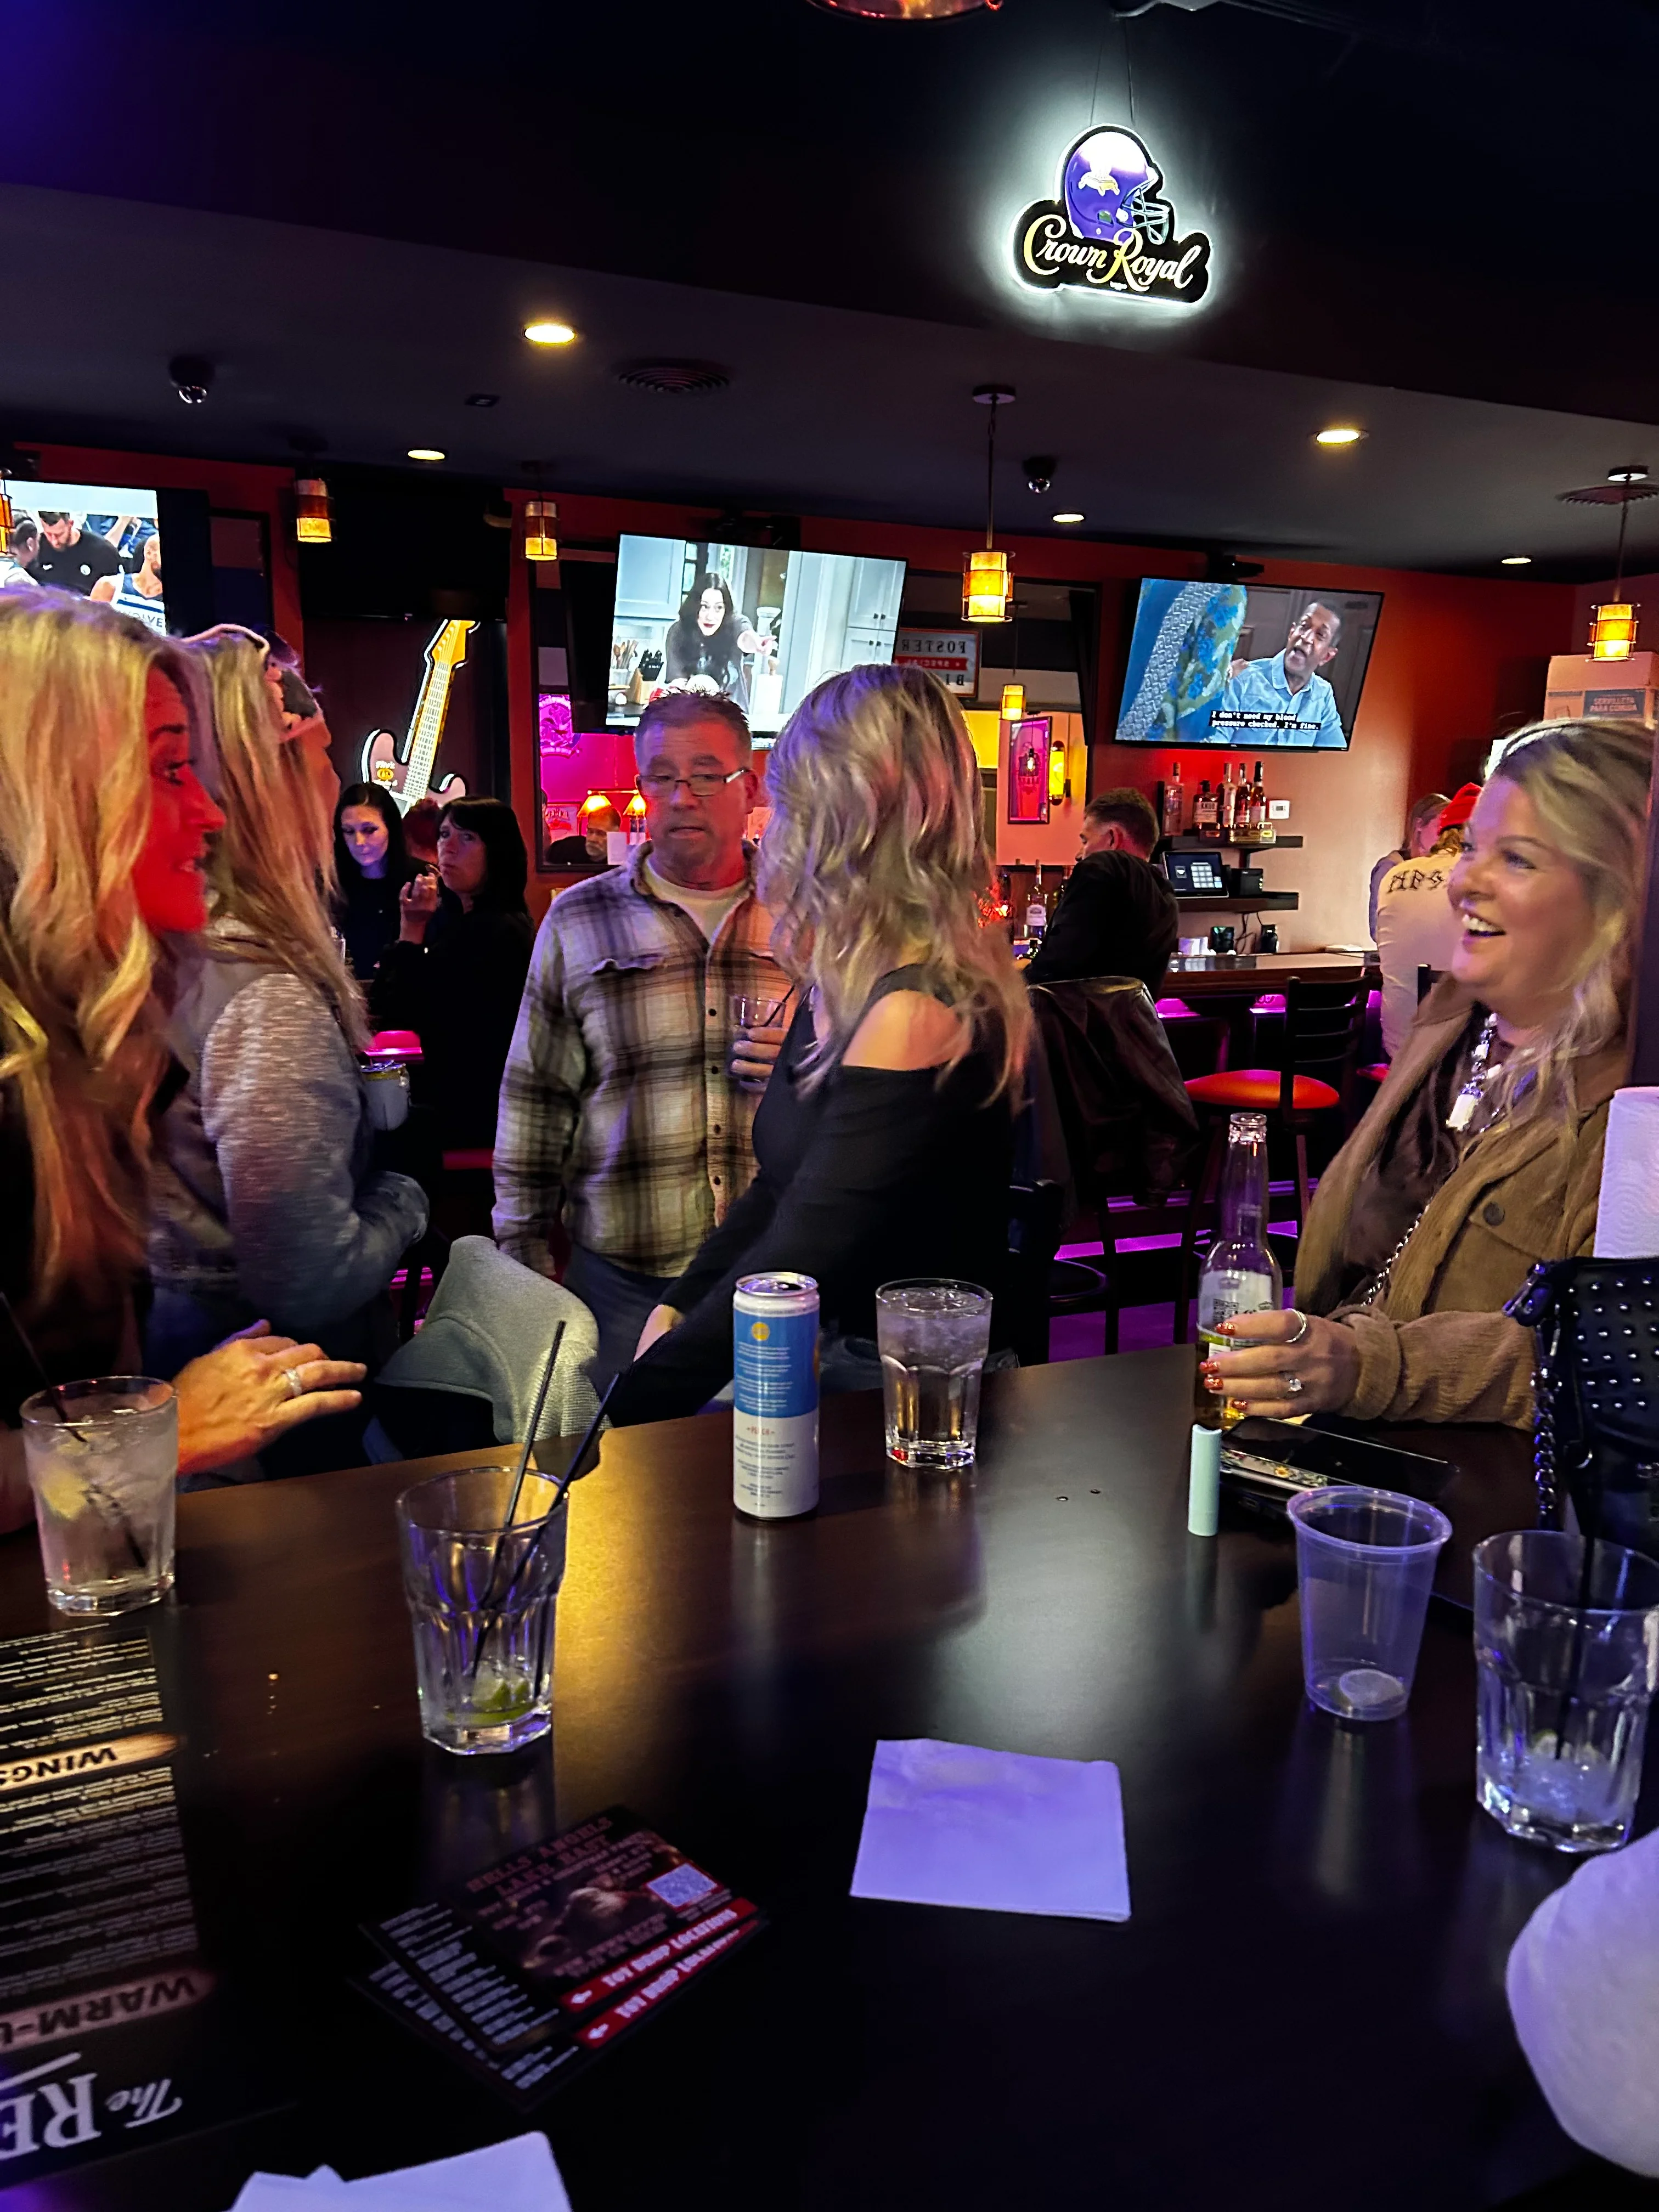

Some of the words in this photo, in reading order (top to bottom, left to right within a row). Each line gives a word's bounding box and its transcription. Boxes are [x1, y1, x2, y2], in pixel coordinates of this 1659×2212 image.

[1023, 214, 1107, 276] Crown
[1086, 228, 1203, 292] Royal
[1219, 711, 1241, 719] don't
[751, 1426, 770, 1436] PECH
[602, 1966, 634, 1987] TOY
[670, 1908, 738, 1950] LOCATIONS
[105, 2078, 183, 2129] The
